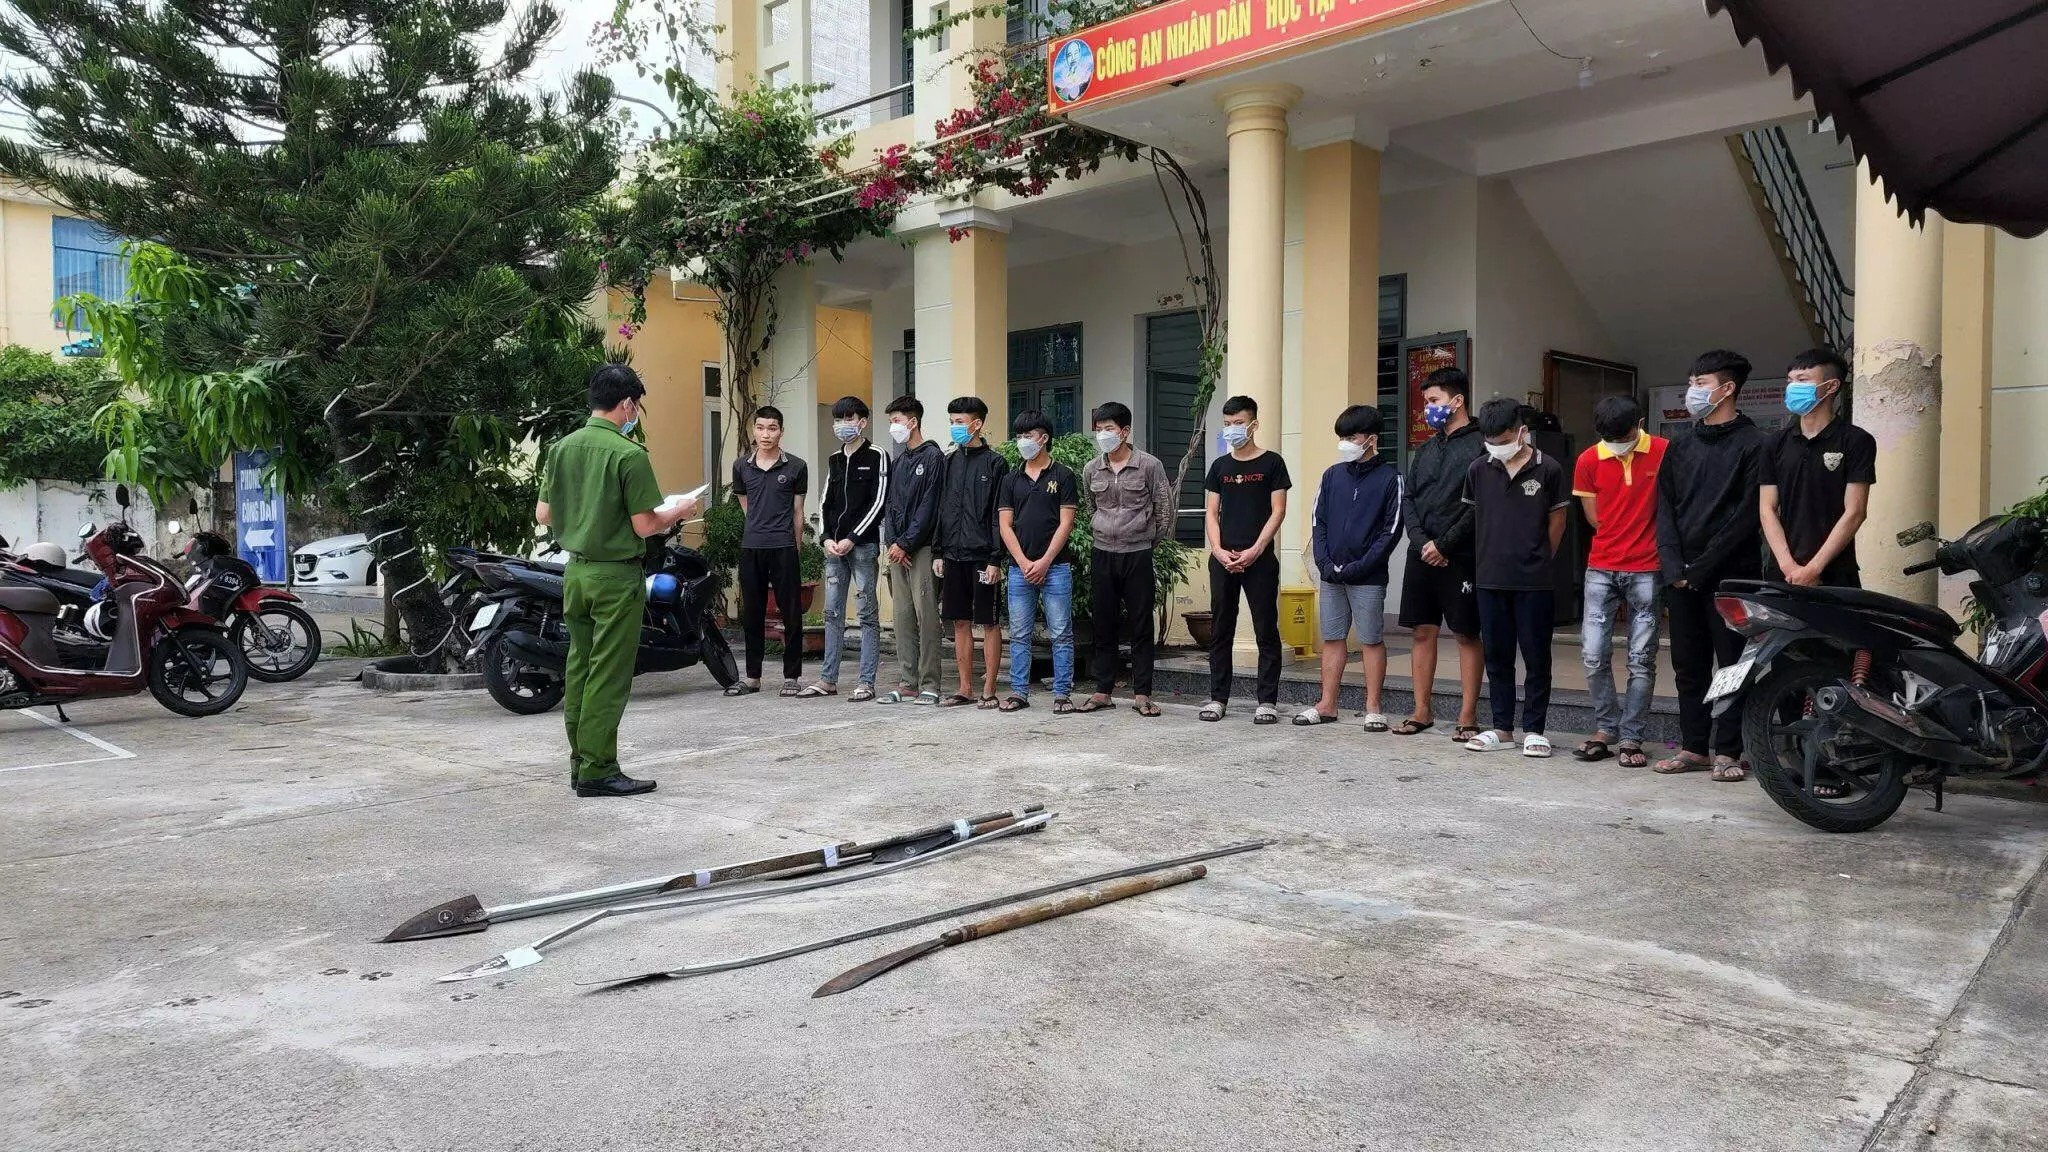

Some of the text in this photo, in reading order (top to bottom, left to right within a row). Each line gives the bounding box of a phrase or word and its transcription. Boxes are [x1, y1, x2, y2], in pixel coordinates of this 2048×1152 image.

[1096, 37, 1137, 82] CÔNG
[1140, 29, 1163, 69] AN
[1166, 10, 1212, 61] NHÂN
[1216, 0, 1252, 46] DÂN
